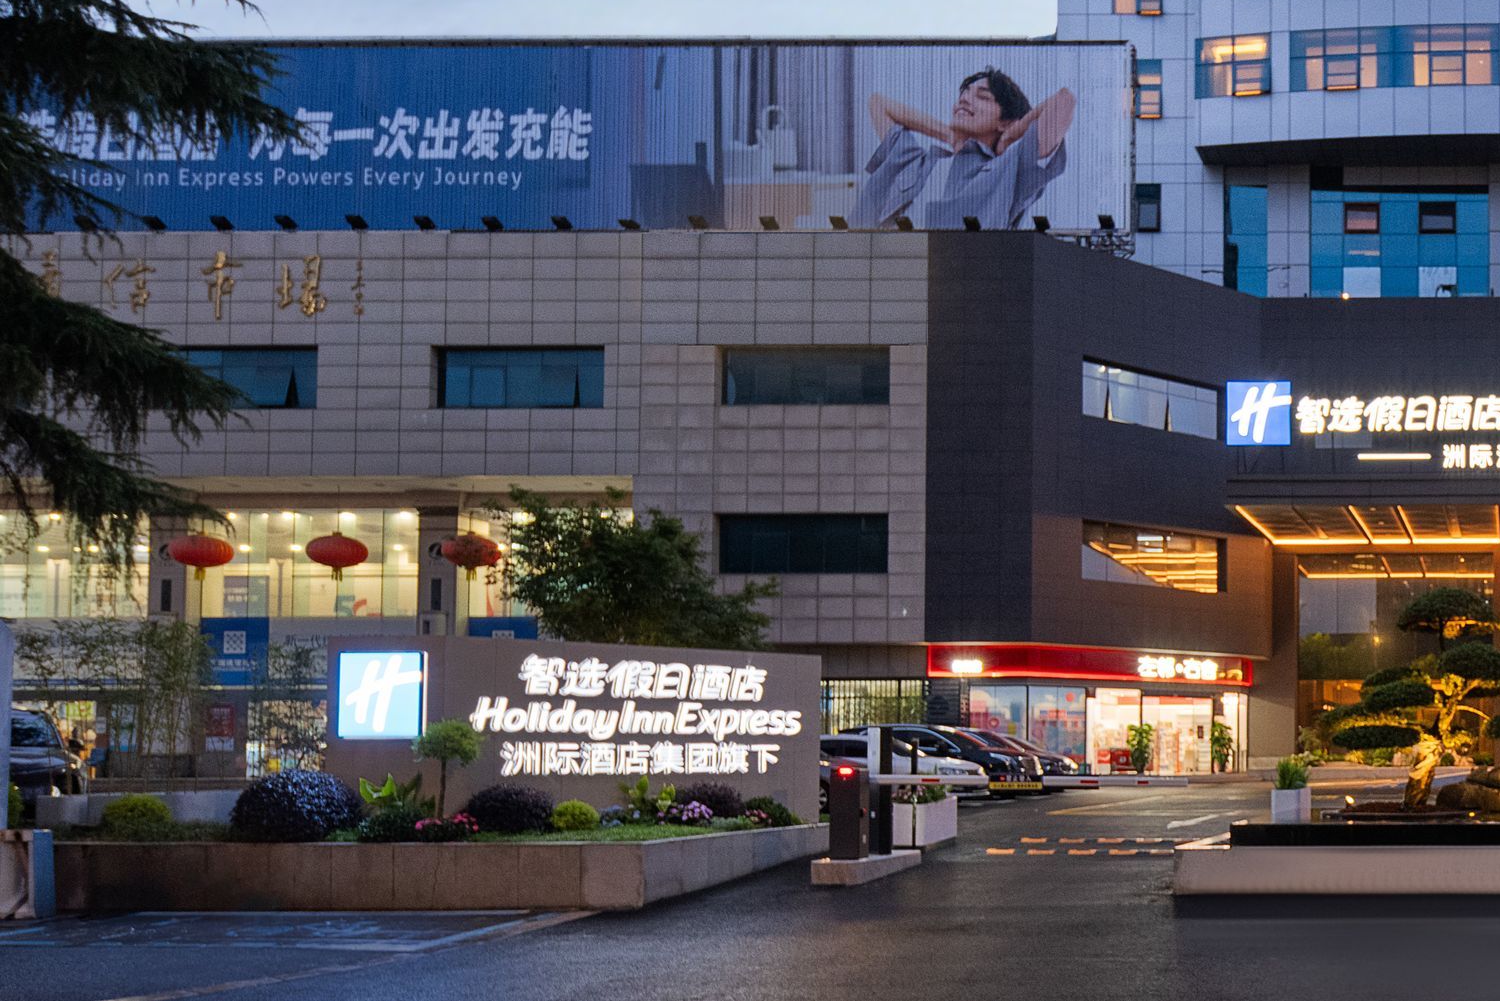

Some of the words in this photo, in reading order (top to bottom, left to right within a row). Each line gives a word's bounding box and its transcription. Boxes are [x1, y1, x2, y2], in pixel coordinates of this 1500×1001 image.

[136, 168, 170, 186] Inn
[178, 167, 264, 191] Express
[273, 168, 353, 187] Powers
[363, 168, 425, 191] Every
[433, 168, 523, 191] Journey
[518, 653, 767, 702] 智选假日酒店
[469, 696, 618, 740] Holiday
[620, 701, 679, 735] Inn
[677, 703, 802, 742] Express
[499, 741, 781, 777] 洲际酒店集团旗下
